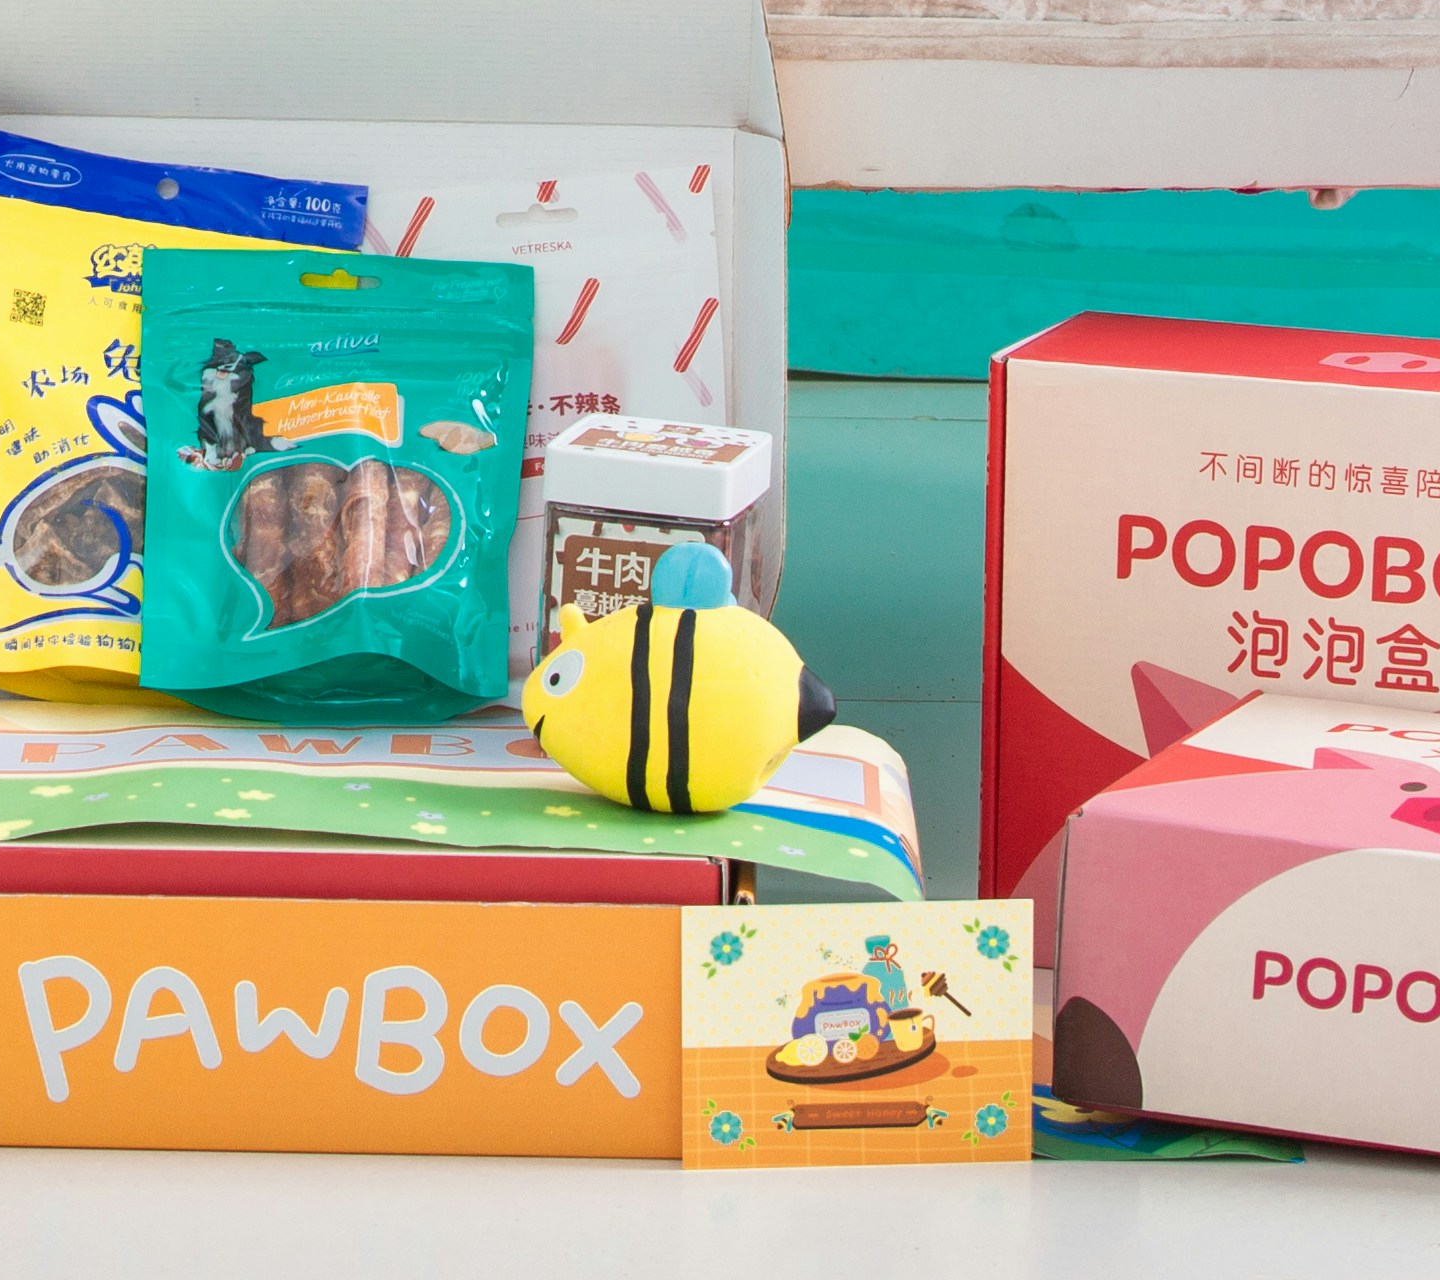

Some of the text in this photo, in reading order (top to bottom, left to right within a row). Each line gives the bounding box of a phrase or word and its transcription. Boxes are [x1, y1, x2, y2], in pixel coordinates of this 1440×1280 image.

[511, 240, 573, 255] VETRESKA
[310, 332, 380, 354] activa
[33, 433, 90, 465] 助消化
[575, 546, 652, 591] 牛肉
[1226, 609, 1440, 694] 泡泡盒
[18, 955, 644, 1103] PAWBOX
[822, 1019, 862, 1032] PAWBOX
